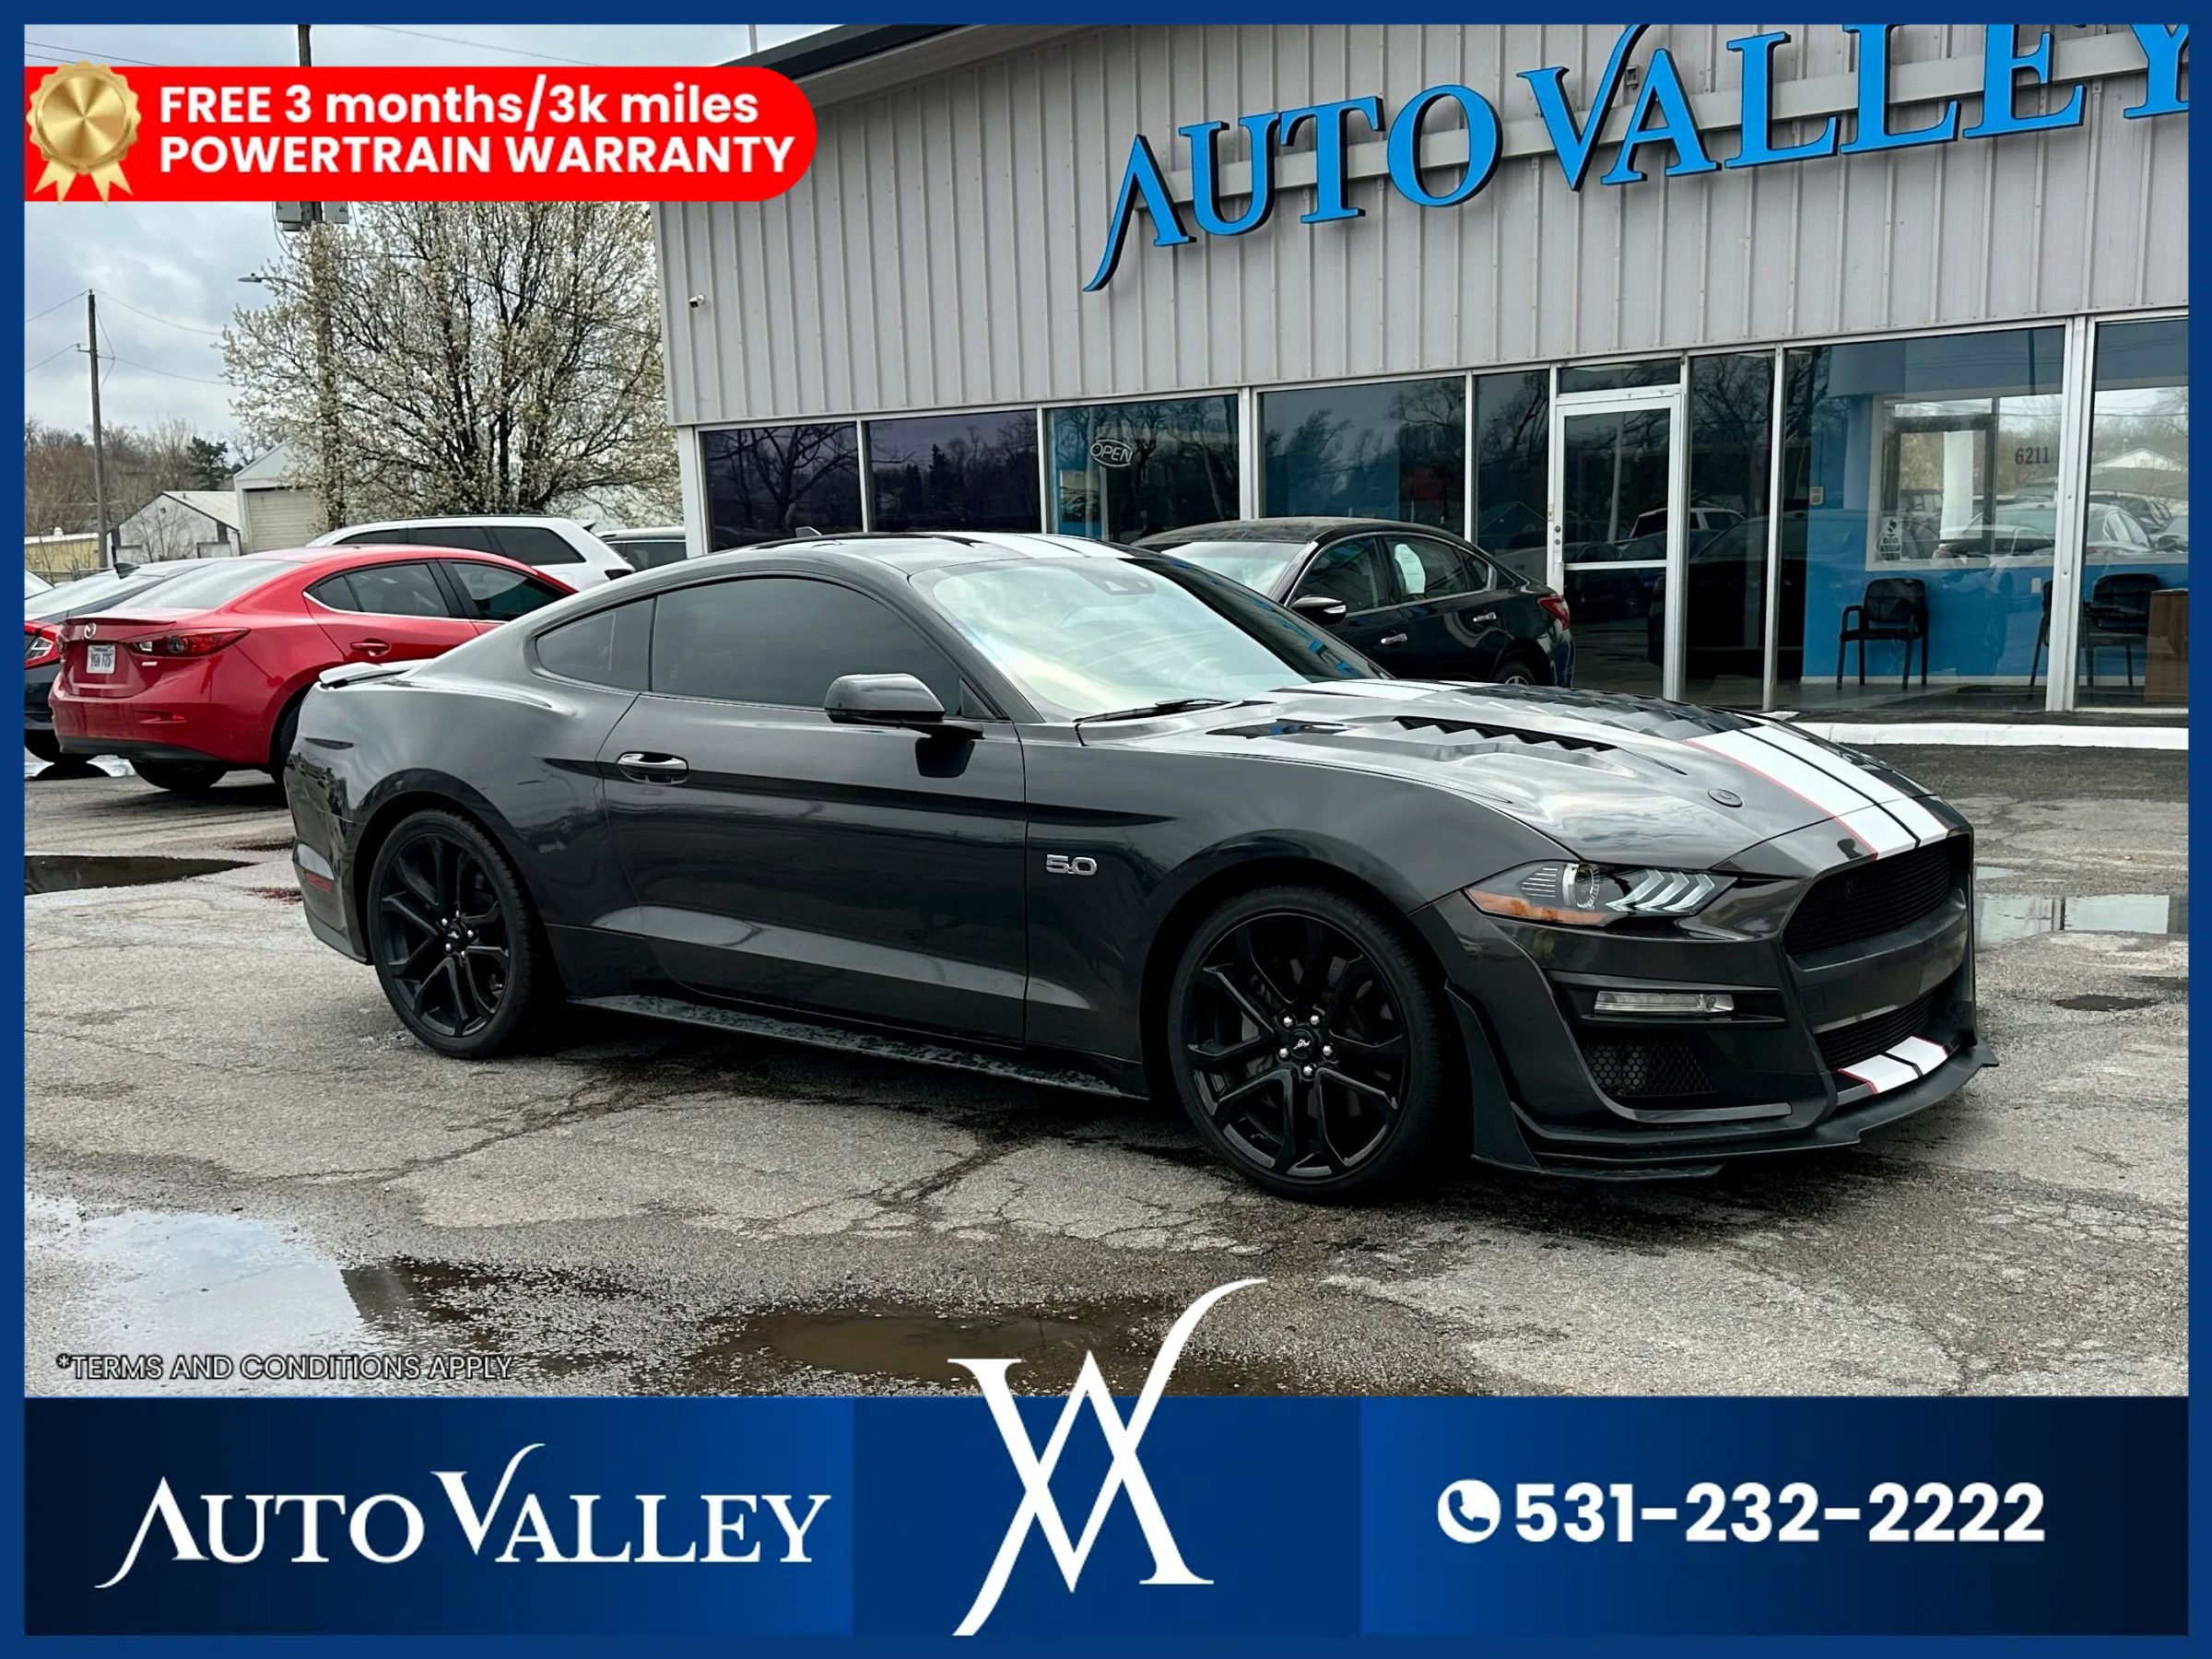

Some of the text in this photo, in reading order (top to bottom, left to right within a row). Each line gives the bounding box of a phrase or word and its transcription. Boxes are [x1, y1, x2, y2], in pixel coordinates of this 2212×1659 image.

[1084, 24, 2188, 293] AUTO VALLEY
[1090, 442, 1133, 463] OPEN
[2015, 447, 2050, 465] 6211
[1046, 853, 1098, 876] 5.0
